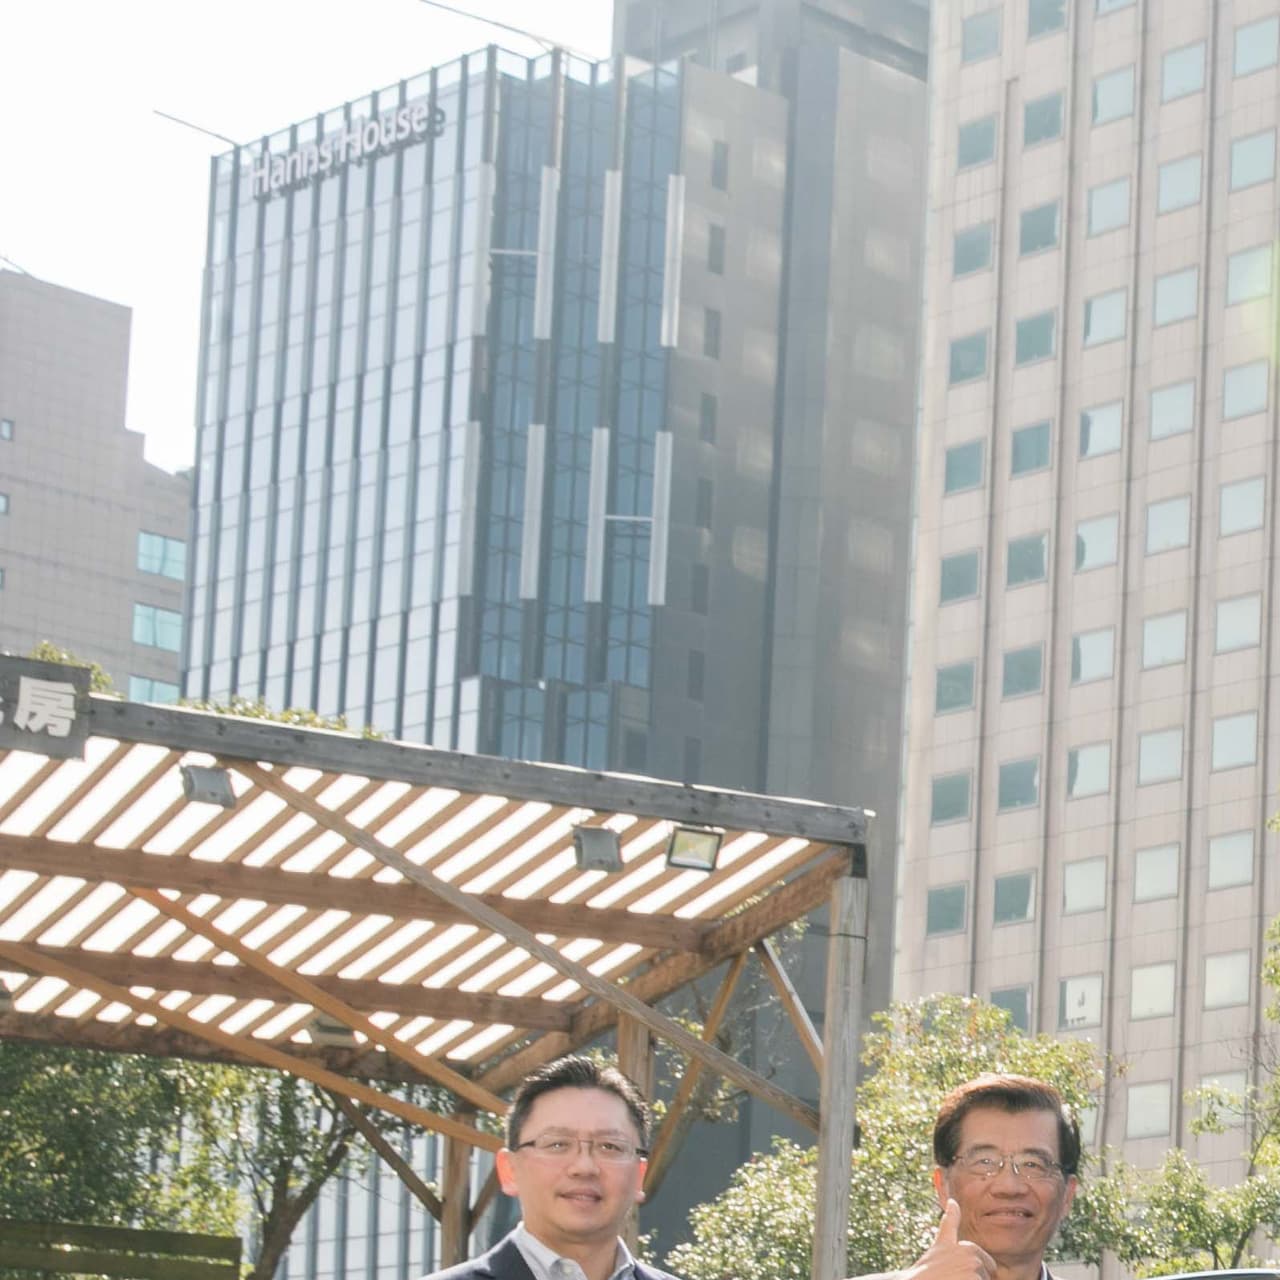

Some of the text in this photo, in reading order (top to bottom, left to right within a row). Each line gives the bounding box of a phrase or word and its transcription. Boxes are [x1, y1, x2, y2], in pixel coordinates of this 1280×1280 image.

[250, 102, 430, 195] Hanns House
[0, 675, 77, 737] 房
